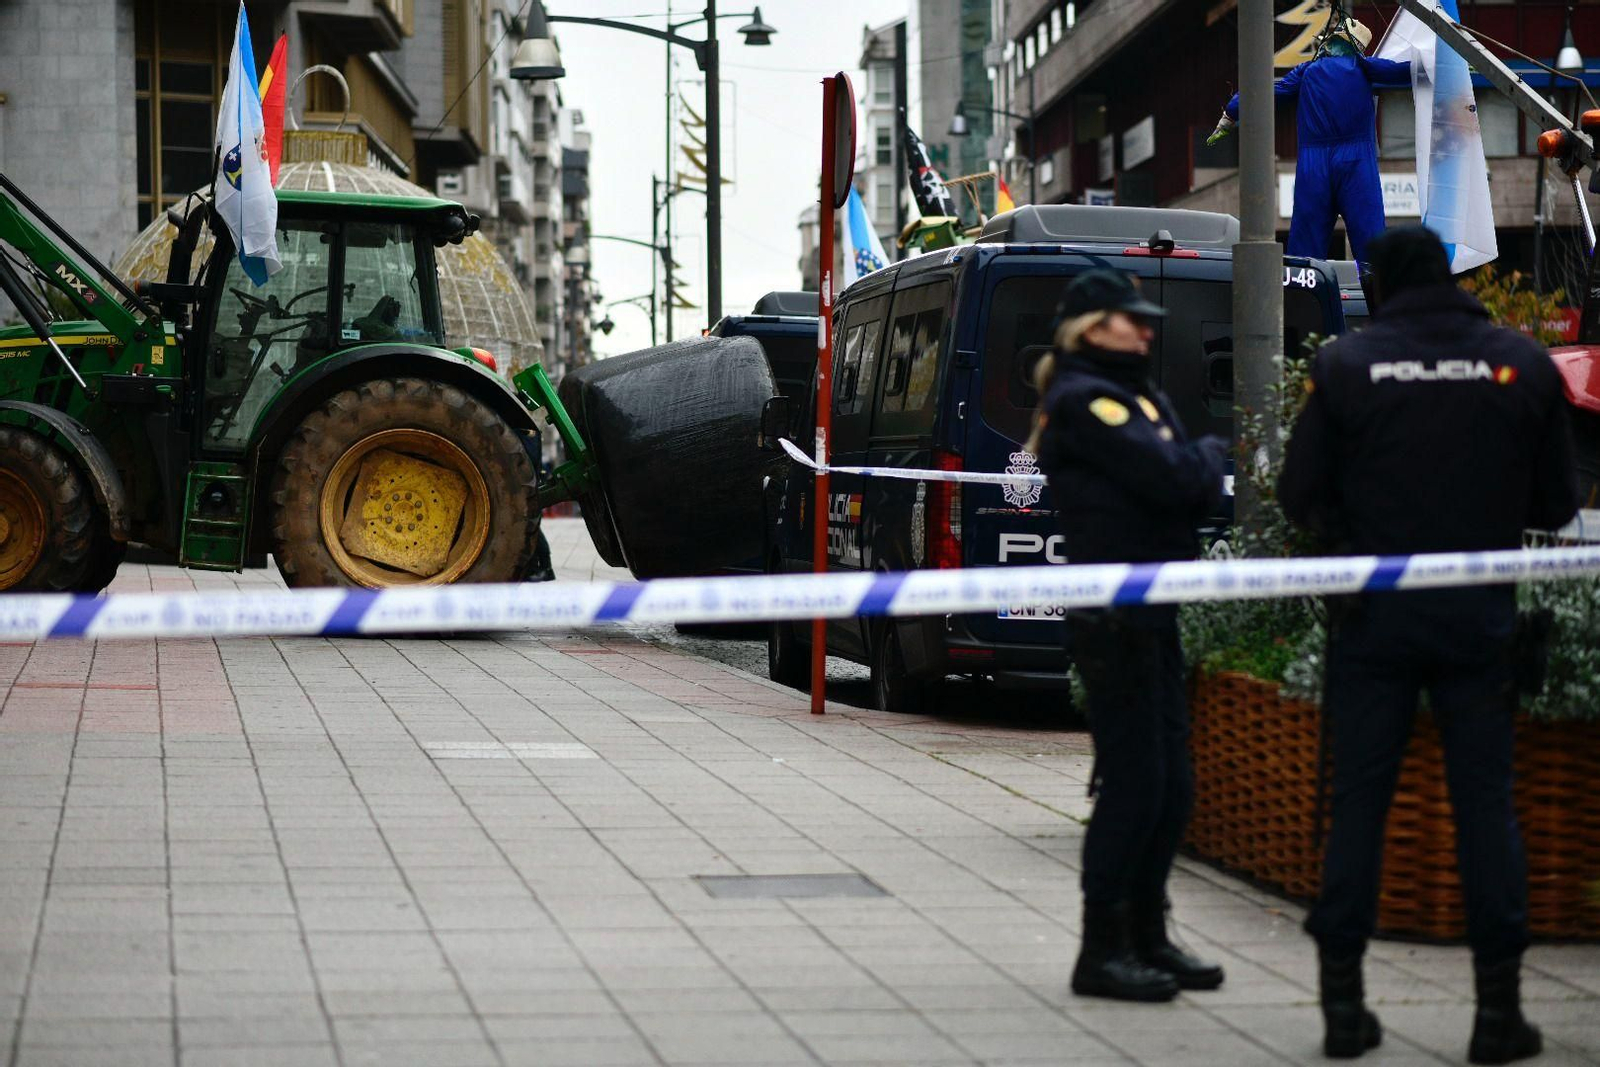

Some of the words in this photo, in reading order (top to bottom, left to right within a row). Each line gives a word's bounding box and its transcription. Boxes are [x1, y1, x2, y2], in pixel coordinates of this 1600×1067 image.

[55, 264, 88, 294] MX
[83, 337, 108, 345] JOHN
[1370, 360, 1494, 384] POLICIA
[828, 493, 851, 523] LICIA
[828, 527, 861, 559] CIONAL
